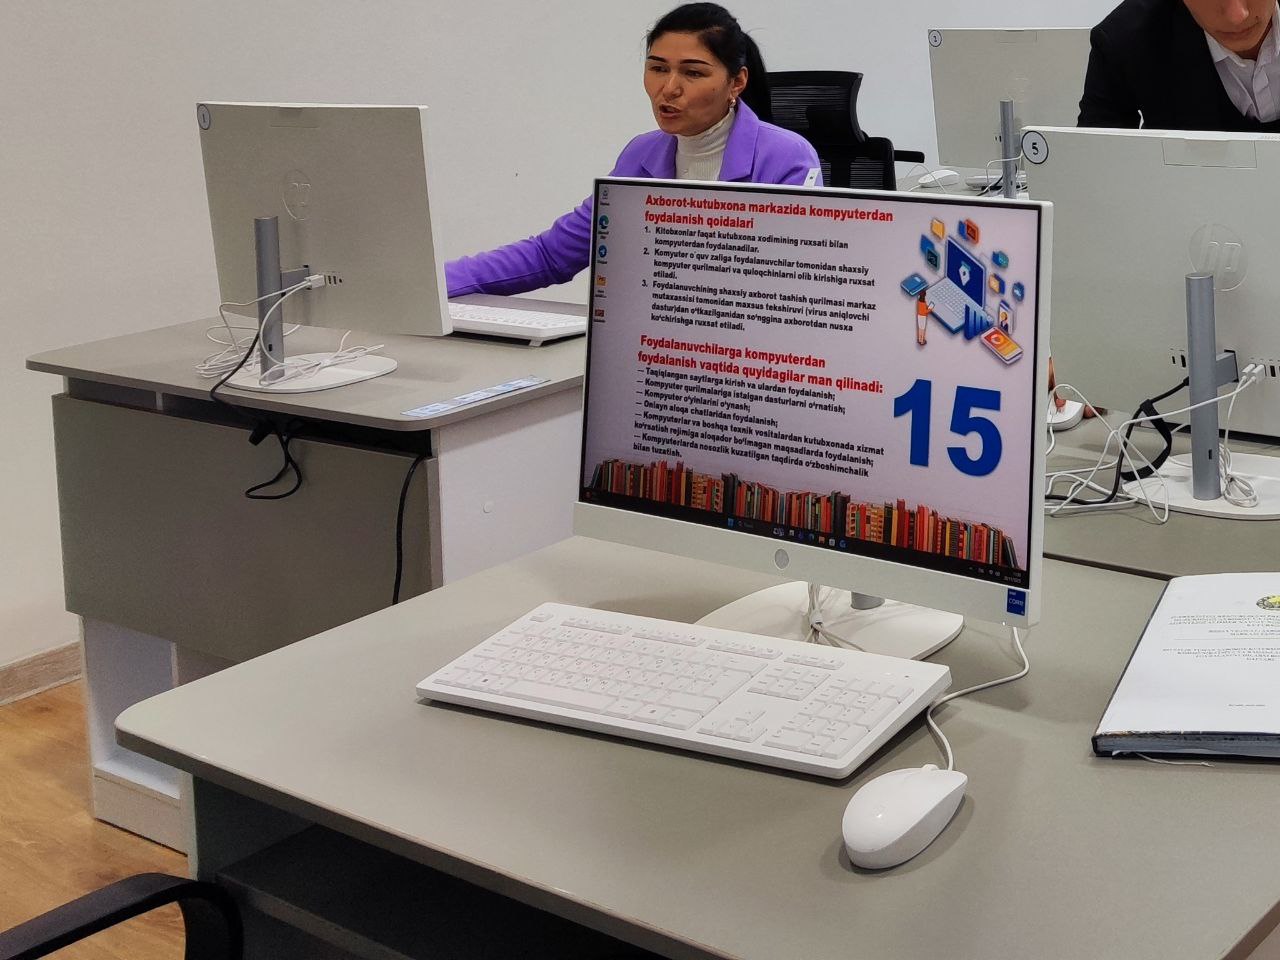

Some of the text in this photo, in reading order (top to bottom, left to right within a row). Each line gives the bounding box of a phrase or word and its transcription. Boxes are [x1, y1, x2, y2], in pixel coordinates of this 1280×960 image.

[1032, 142, 1039, 156] 5
[645, 211, 754, 229] foydalanish qoidalari
[646, 195, 893, 221] Axborot-kutubxona markazida kompyuterdan
[655, 227, 696, 237] Kitobxonlar
[698, 230, 716, 240] faqat
[718, 231, 756, 242] kutubxona
[758, 235, 799, 247] xodimining
[800, 239, 827, 248] ruxsati
[829, 241, 848, 249] bilan
[655, 237, 705, 249] kompyuterdan
[654, 248, 688, 260] Komyuter
[734, 255, 795, 268] foydalanuvchilar
[796, 261, 836, 271] tomonidan
[839, 264, 869, 276] shaxsiy
[654, 259, 691, 270] kompyuter
[692, 263, 731, 273] qurilmalari
[743, 268, 796, 279] quloqchinlarni
[798, 272, 812, 281] olib
[814, 273, 847, 285] kirishiga
[849, 278, 875, 287] ruxsat
[652, 293, 870, 321] mutaxassisi tomonidan maxsus tekshiruvi (virus aniqlovchi
[653, 281, 718, 296] Foydalanuvchining
[719, 286, 747, 298] shaxsiy
[748, 290, 777, 300] axborot
[779, 293, 807, 303] tashish
[809, 297, 845, 307] qurilmasi
[847, 301, 876, 310] markaz
[695, 319, 718, 328] ruxsat
[784, 317, 827, 329] axborotdan
[830, 324, 853, 332] nusxa
[641, 335, 825, 368] Foydalanuvchilarga kompyuterdan
[638, 351, 883, 393] foydalanish vaqtida quyidagilar man qilinadi:
[646, 367, 688, 380] Taqiqlangan
[690, 375, 723, 386] saytlarga
[725, 377, 745, 388] kirish
[747, 382, 756, 390] va
[758, 383, 786, 393] ulardan
[644, 389, 683, 401] Kompyuter
[645, 378, 683, 390] Kompyuter
[684, 385, 731, 398] qurilmalariga
[733, 390, 763, 403] istalgan
[765, 395, 806, 408] dasturlarni
[644, 400, 668, 411] Onlayn
[669, 405, 689, 414] aloqa
[691, 408, 731, 420] chatlaridan
[643, 411, 691, 425] Kompyuterlar
[702, 420, 728, 431] boshqa
[730, 424, 753, 435] texnik
[755, 430, 803, 443] vositalardan
[804, 436, 855, 451] kutubxonada
[857, 444, 884, 456] xizmat
[894, 379, 1003, 477] 15
[633, 442, 651, 453] bilan
[642, 433, 698, 449] Kompyuterlarda
[700, 442, 729, 454] nosozlik
[731, 447, 770, 461] kuzatilgan
[772, 454, 803, 467] taqdirda
[670, 427, 699, 439] rejimiga
[700, 432, 732, 443] aloqador
[774, 444, 823, 458] maqsadlarda
[825, 451, 874, 467] foydalanish;
